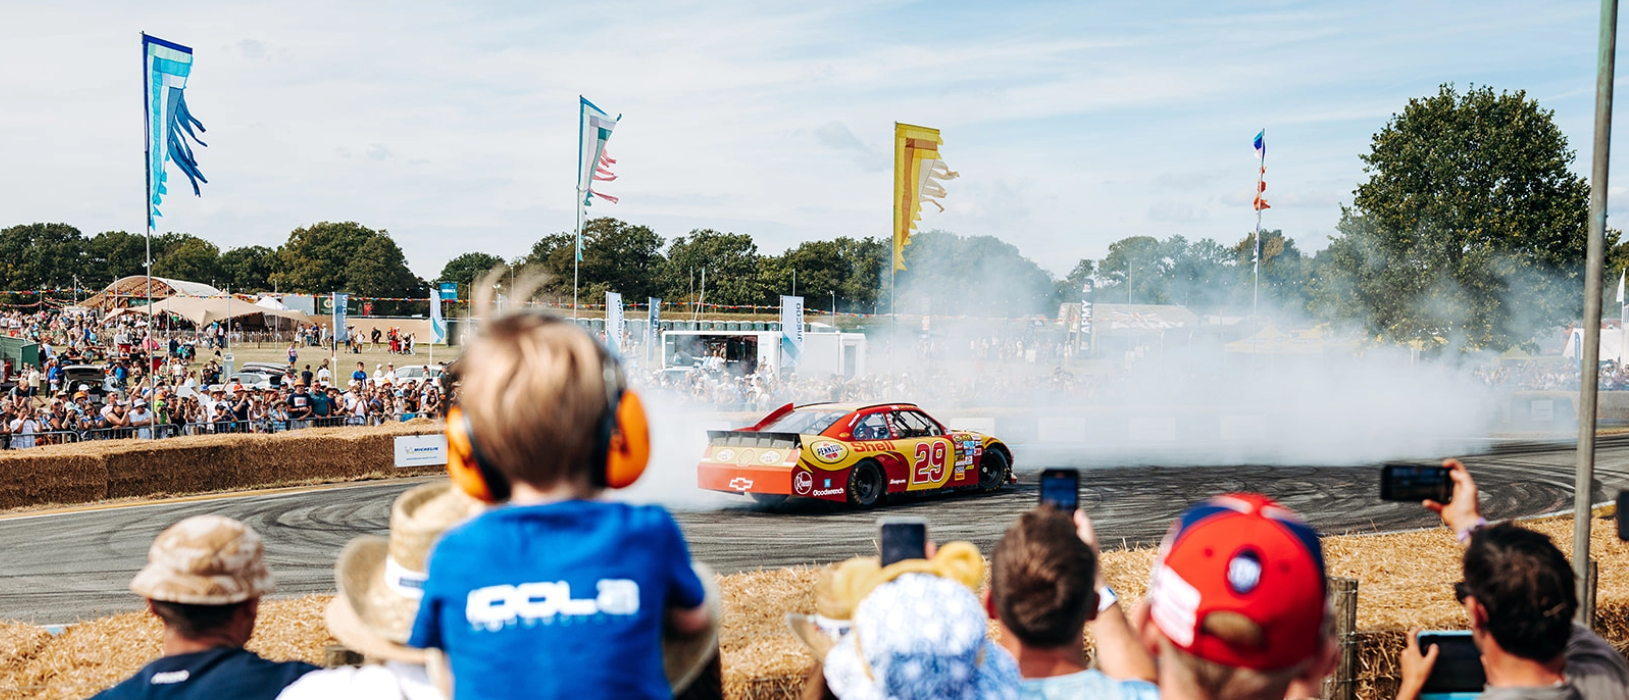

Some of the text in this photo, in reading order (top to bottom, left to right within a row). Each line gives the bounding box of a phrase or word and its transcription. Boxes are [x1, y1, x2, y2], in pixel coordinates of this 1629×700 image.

[795, 302, 803, 343] JAECOO
[1081, 299, 1092, 335] ARMY
[816, 443, 844, 456] PENNZOIL
[850, 440, 896, 453] Shell
[912, 440, 947, 485] 29
[812, 487, 845, 497] Goodwrench
